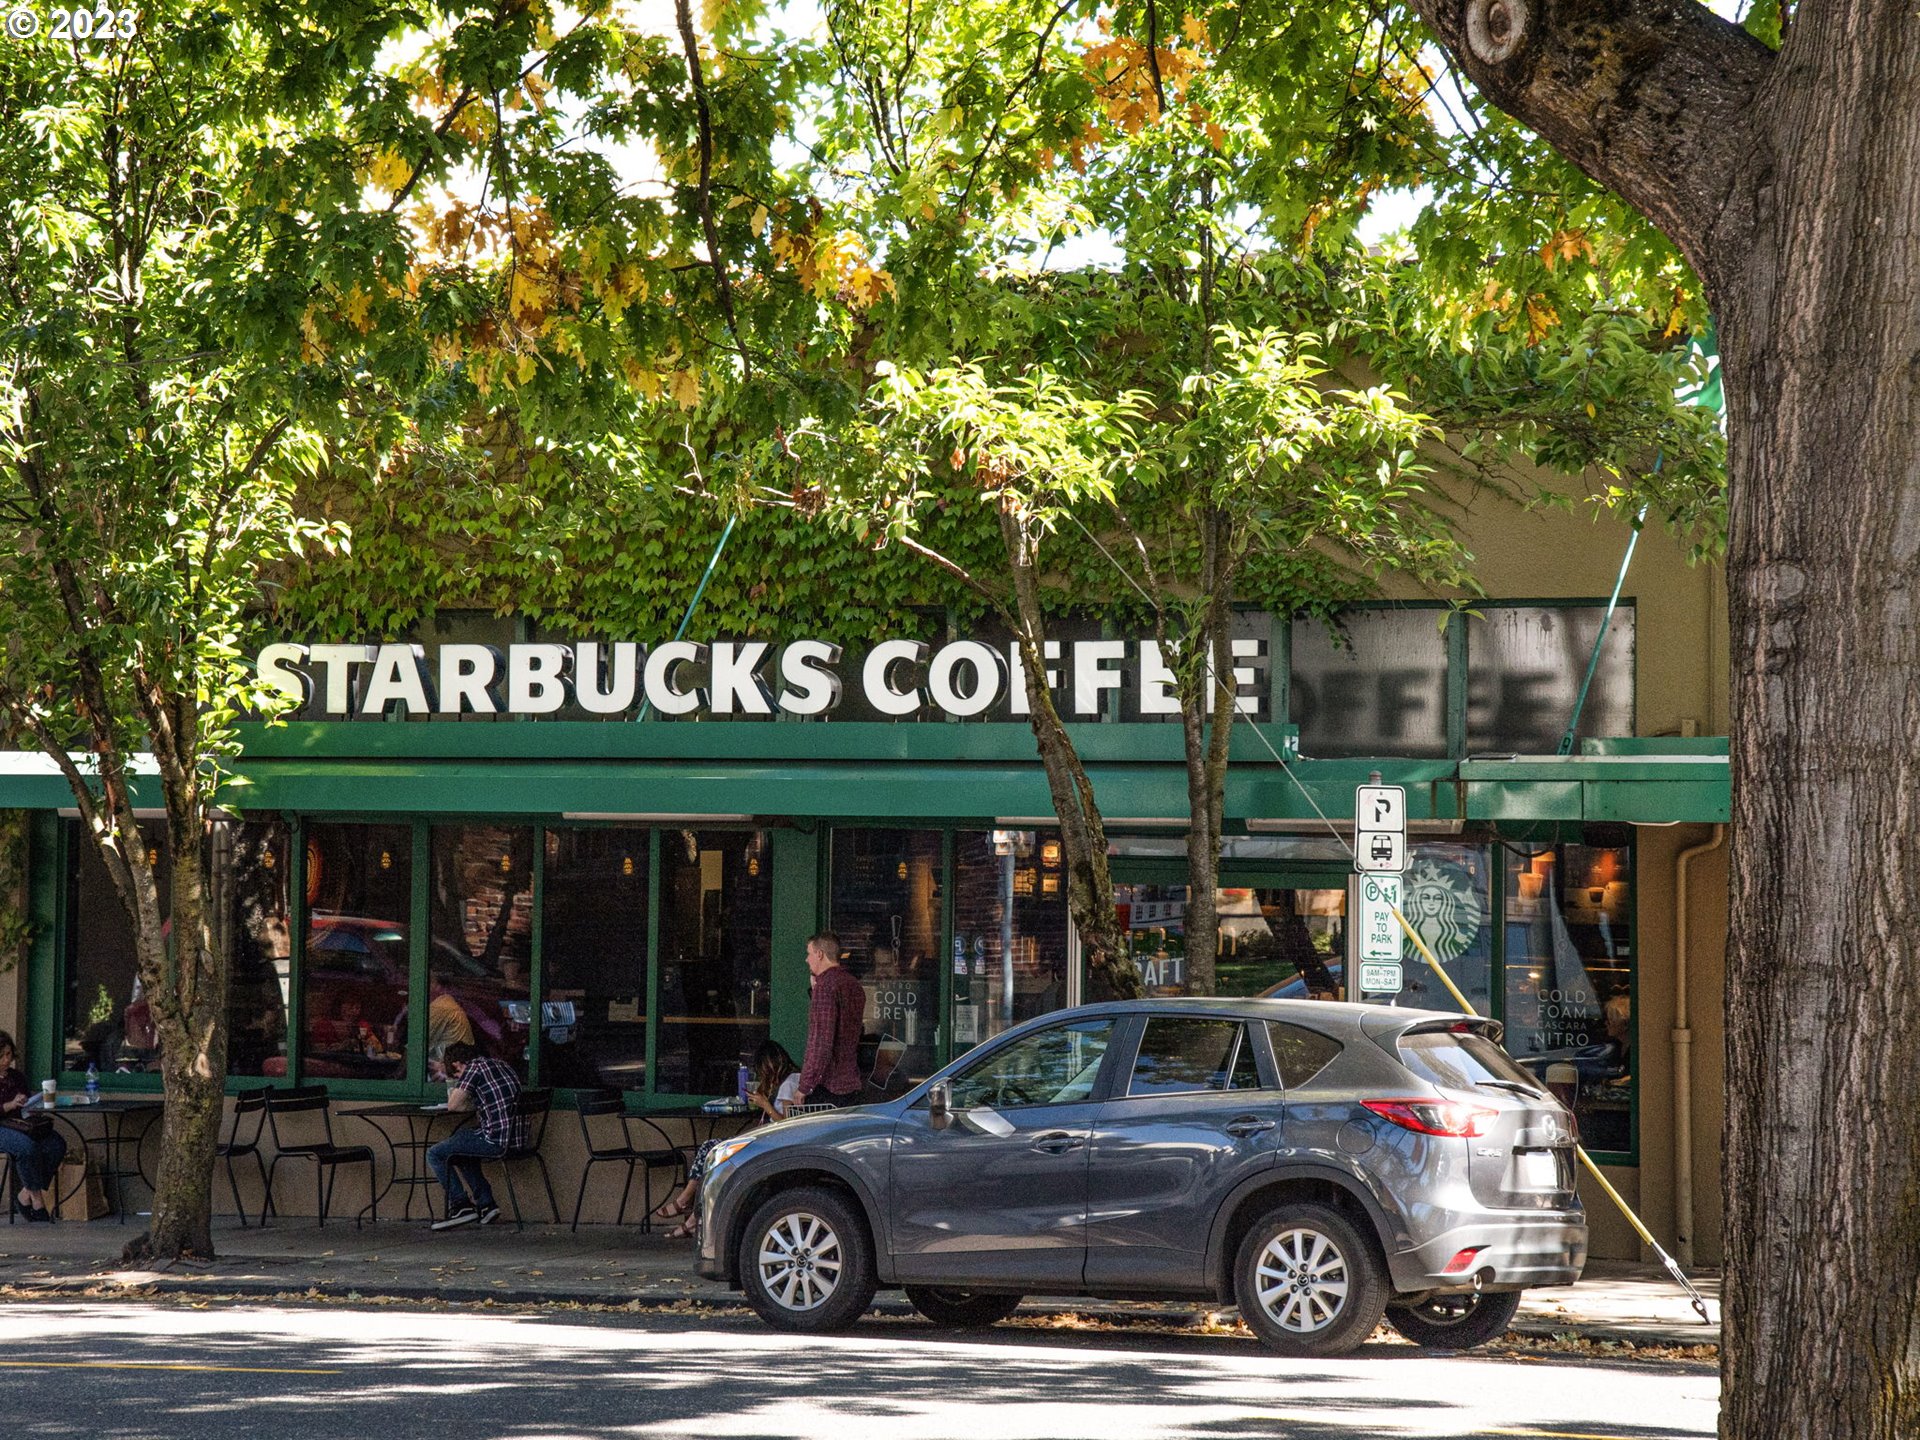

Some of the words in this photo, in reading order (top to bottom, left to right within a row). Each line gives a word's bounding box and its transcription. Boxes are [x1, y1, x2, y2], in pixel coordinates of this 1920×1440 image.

[256, 641, 841, 716] STARBUCKS
[862, 639, 1266, 716] COFFEE
[1374, 911, 1390, 922] PAY
[1376, 922, 1388, 933] TO
[1371, 933, 1393, 944] PARK
[1134, 957, 1185, 986] AFT
[1365, 977, 1397, 986] MON-SAT
[873, 990, 917, 1005] COLD
[1537, 989, 1586, 1003] COLD
[873, 1006, 917, 1020] BREW
[1537, 1004, 1587, 1019] FOAM
[1536, 1020, 1587, 1030] CASCARA
[1534, 1031, 1589, 1046] NITRO
